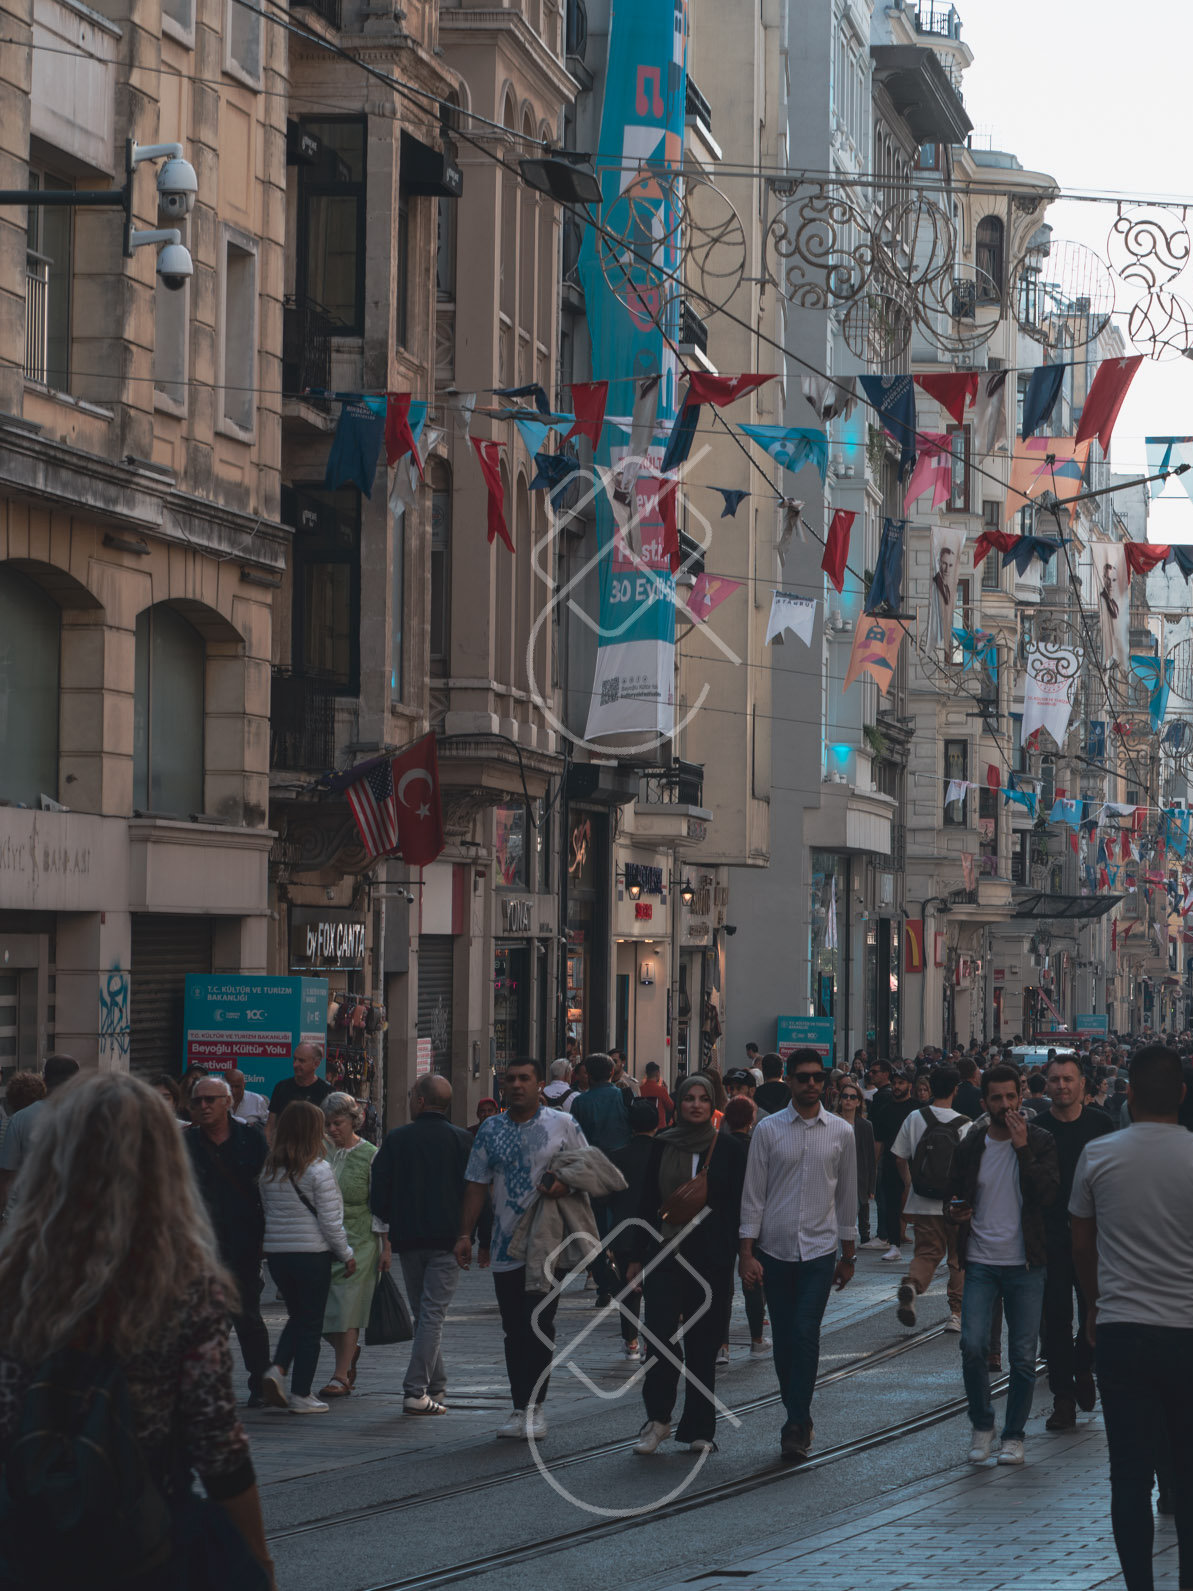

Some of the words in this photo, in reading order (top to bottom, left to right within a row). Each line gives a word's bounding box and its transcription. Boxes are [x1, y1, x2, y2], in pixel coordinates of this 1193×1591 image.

[609, 579, 632, 604] 30
[306, 924, 318, 963] by
[318, 922, 336, 957] FOX
[336, 922, 365, 967] ÇANTA
[207, 985, 220, 993] T.C.
[221, 984, 251, 994] KÜLTÜR
[251, 986, 262, 994] VE
[263, 986, 293, 995] TURİZM
[207, 993, 248, 1002] BAKANLIĞI
[191, 1043, 232, 1056] Beyoğlu
[232, 1044, 264, 1054] Kültür
[265, 1045, 287, 1055] Yolu
